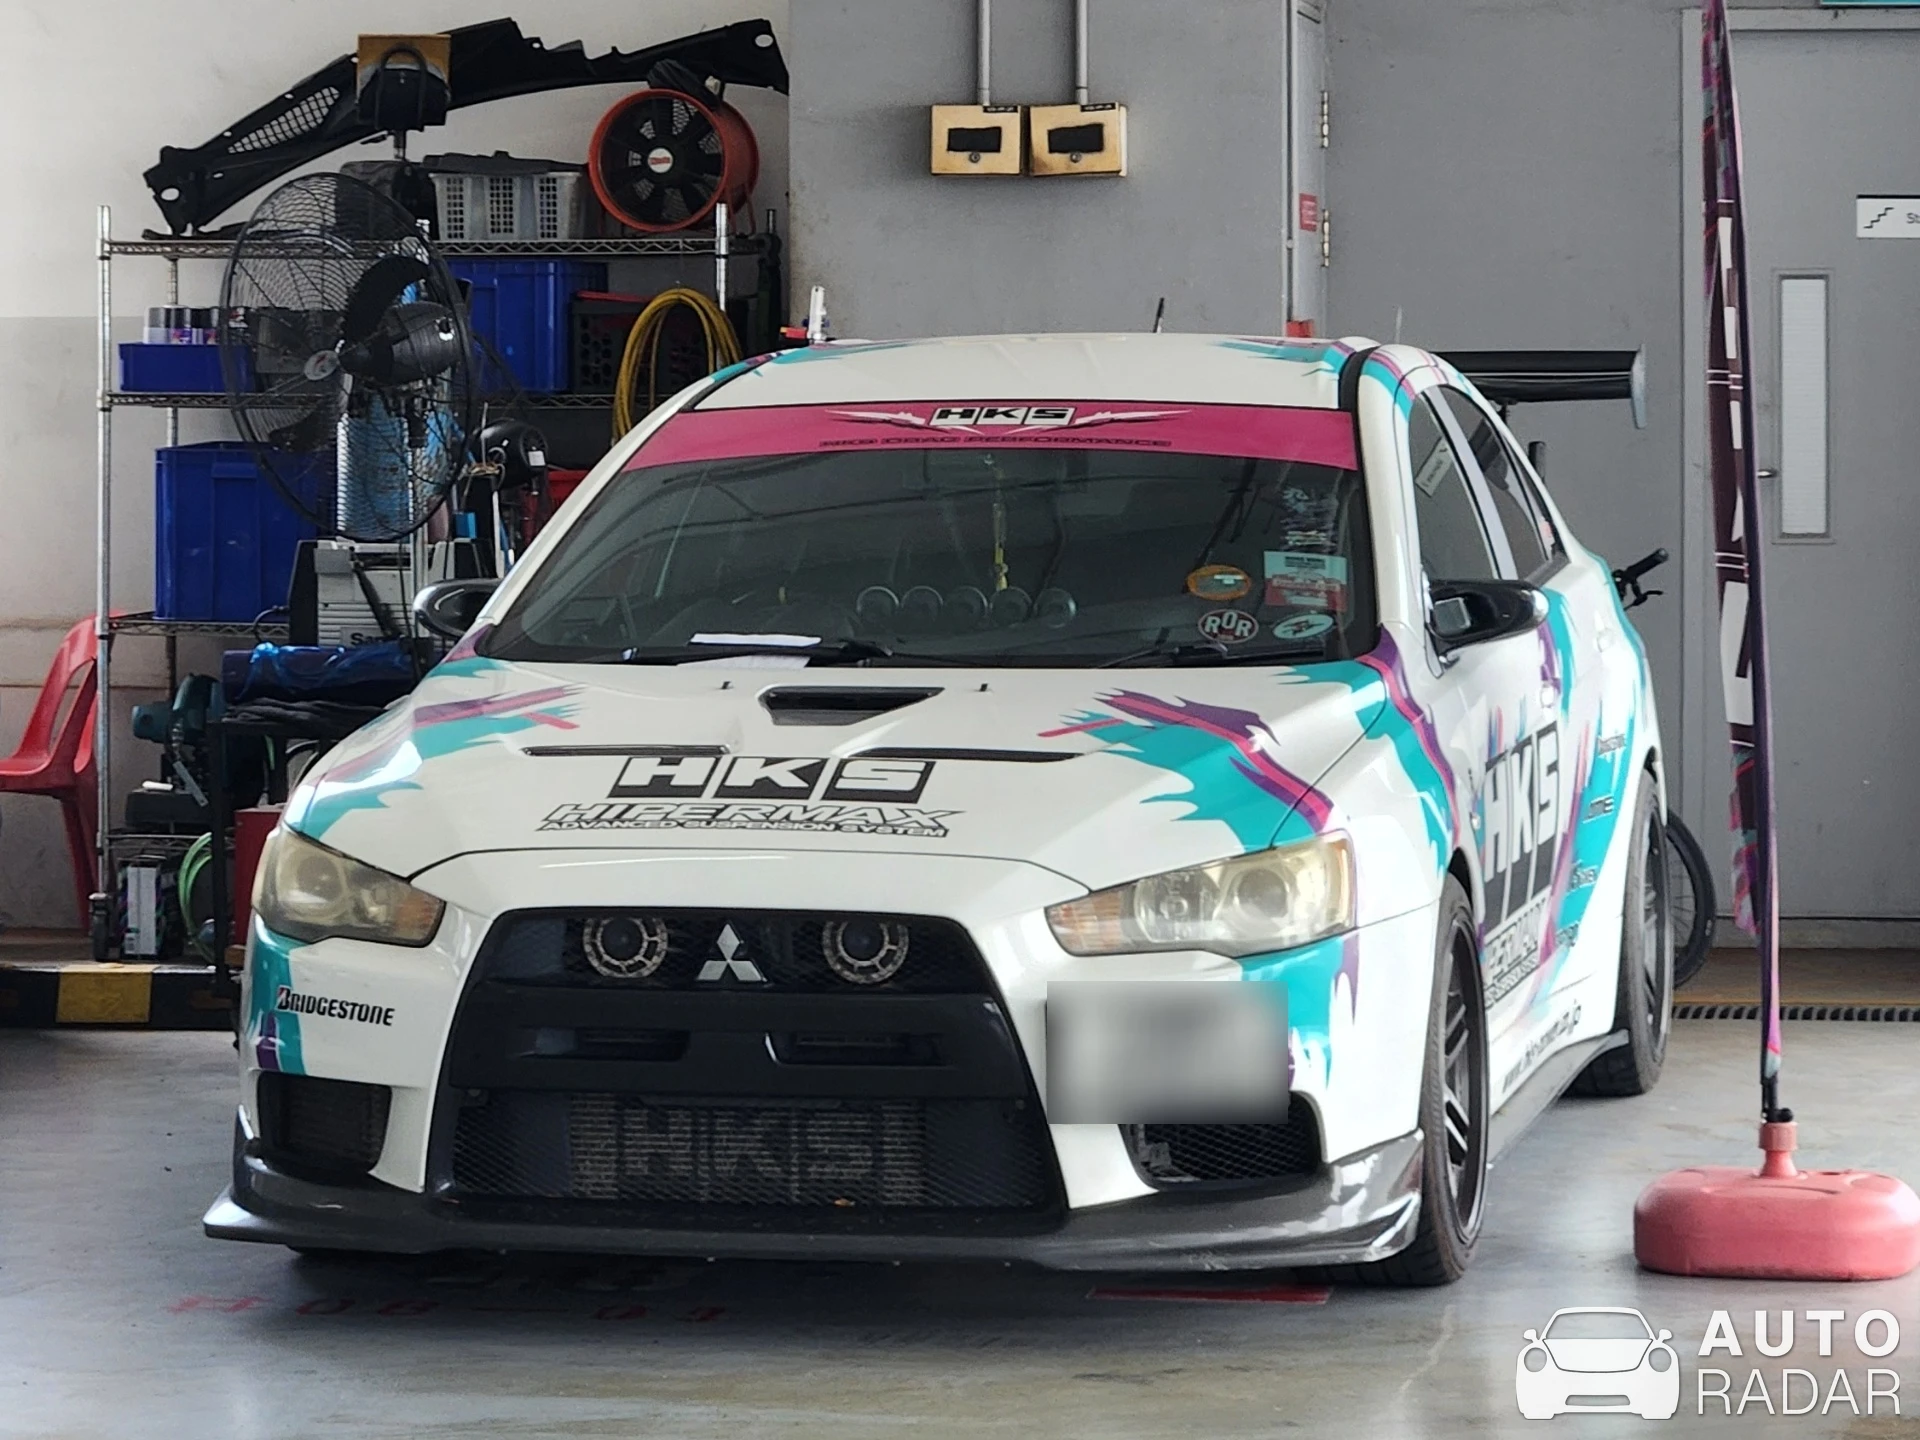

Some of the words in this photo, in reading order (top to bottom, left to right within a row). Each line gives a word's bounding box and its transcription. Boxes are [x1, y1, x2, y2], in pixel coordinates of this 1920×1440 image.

[932, 407, 1073, 424] HKS
[963, 436, 1172, 447] PERFORMANCE
[1204, 611, 1253, 637] ROR
[612, 756, 932, 798] HKS
[542, 803, 964, 830] HIPERMAX
[1484, 728, 1559, 886] HKS
[539, 820, 680, 831] ADVANCED
[683, 820, 836, 832] SUSPENSION
[840, 823, 949, 837] SYSTEM
[277, 986, 395, 1027] BRIDGESTONE
[619, 1103, 880, 1182] HKS
